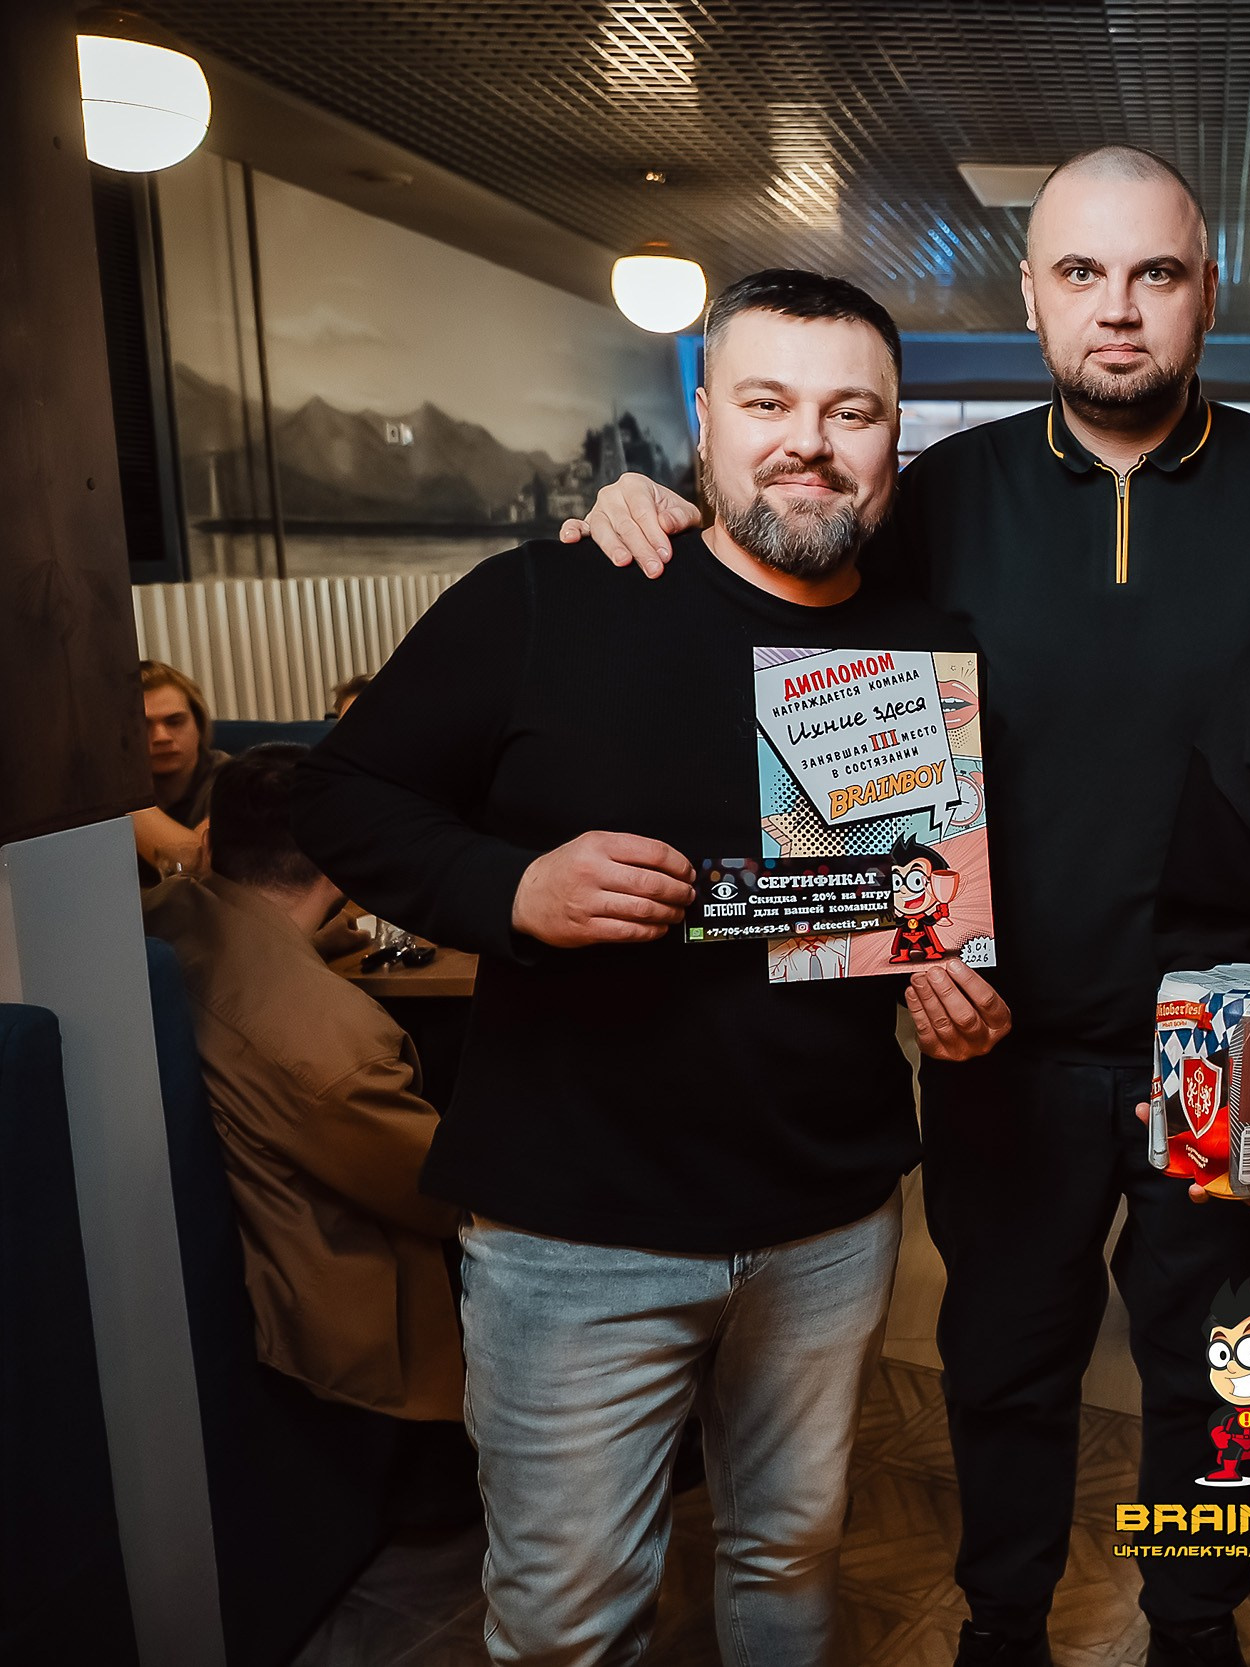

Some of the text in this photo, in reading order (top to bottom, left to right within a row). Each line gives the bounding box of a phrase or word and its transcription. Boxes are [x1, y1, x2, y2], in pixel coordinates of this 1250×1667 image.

[784, 652, 895, 701] ДИПЛОМОМ
[772, 669, 920, 718] НАГРАЖДАЕТСЯ КОМАНДА
[787, 711, 867, 745] Ихние
[801, 744, 868, 770] ЗАНЯВШАЯ
[901, 725, 938, 742] МЕСТО
[831, 746, 919, 779] В СОСТЯЗАНИИ
[827, 759, 947, 821] BRAINBOY
[757, 872, 876, 889] СЕРТИФИКАТ
[703, 902, 747, 917] DETECTIT
[748, 895, 797, 905] Скидка
[812, 892, 836, 902] 20%
[841, 891, 856, 900] на
[861, 890, 891, 902] игру
[753, 901, 888, 918] для вашей команды
[706, 923, 790, 937] +7-705-462-53-56
